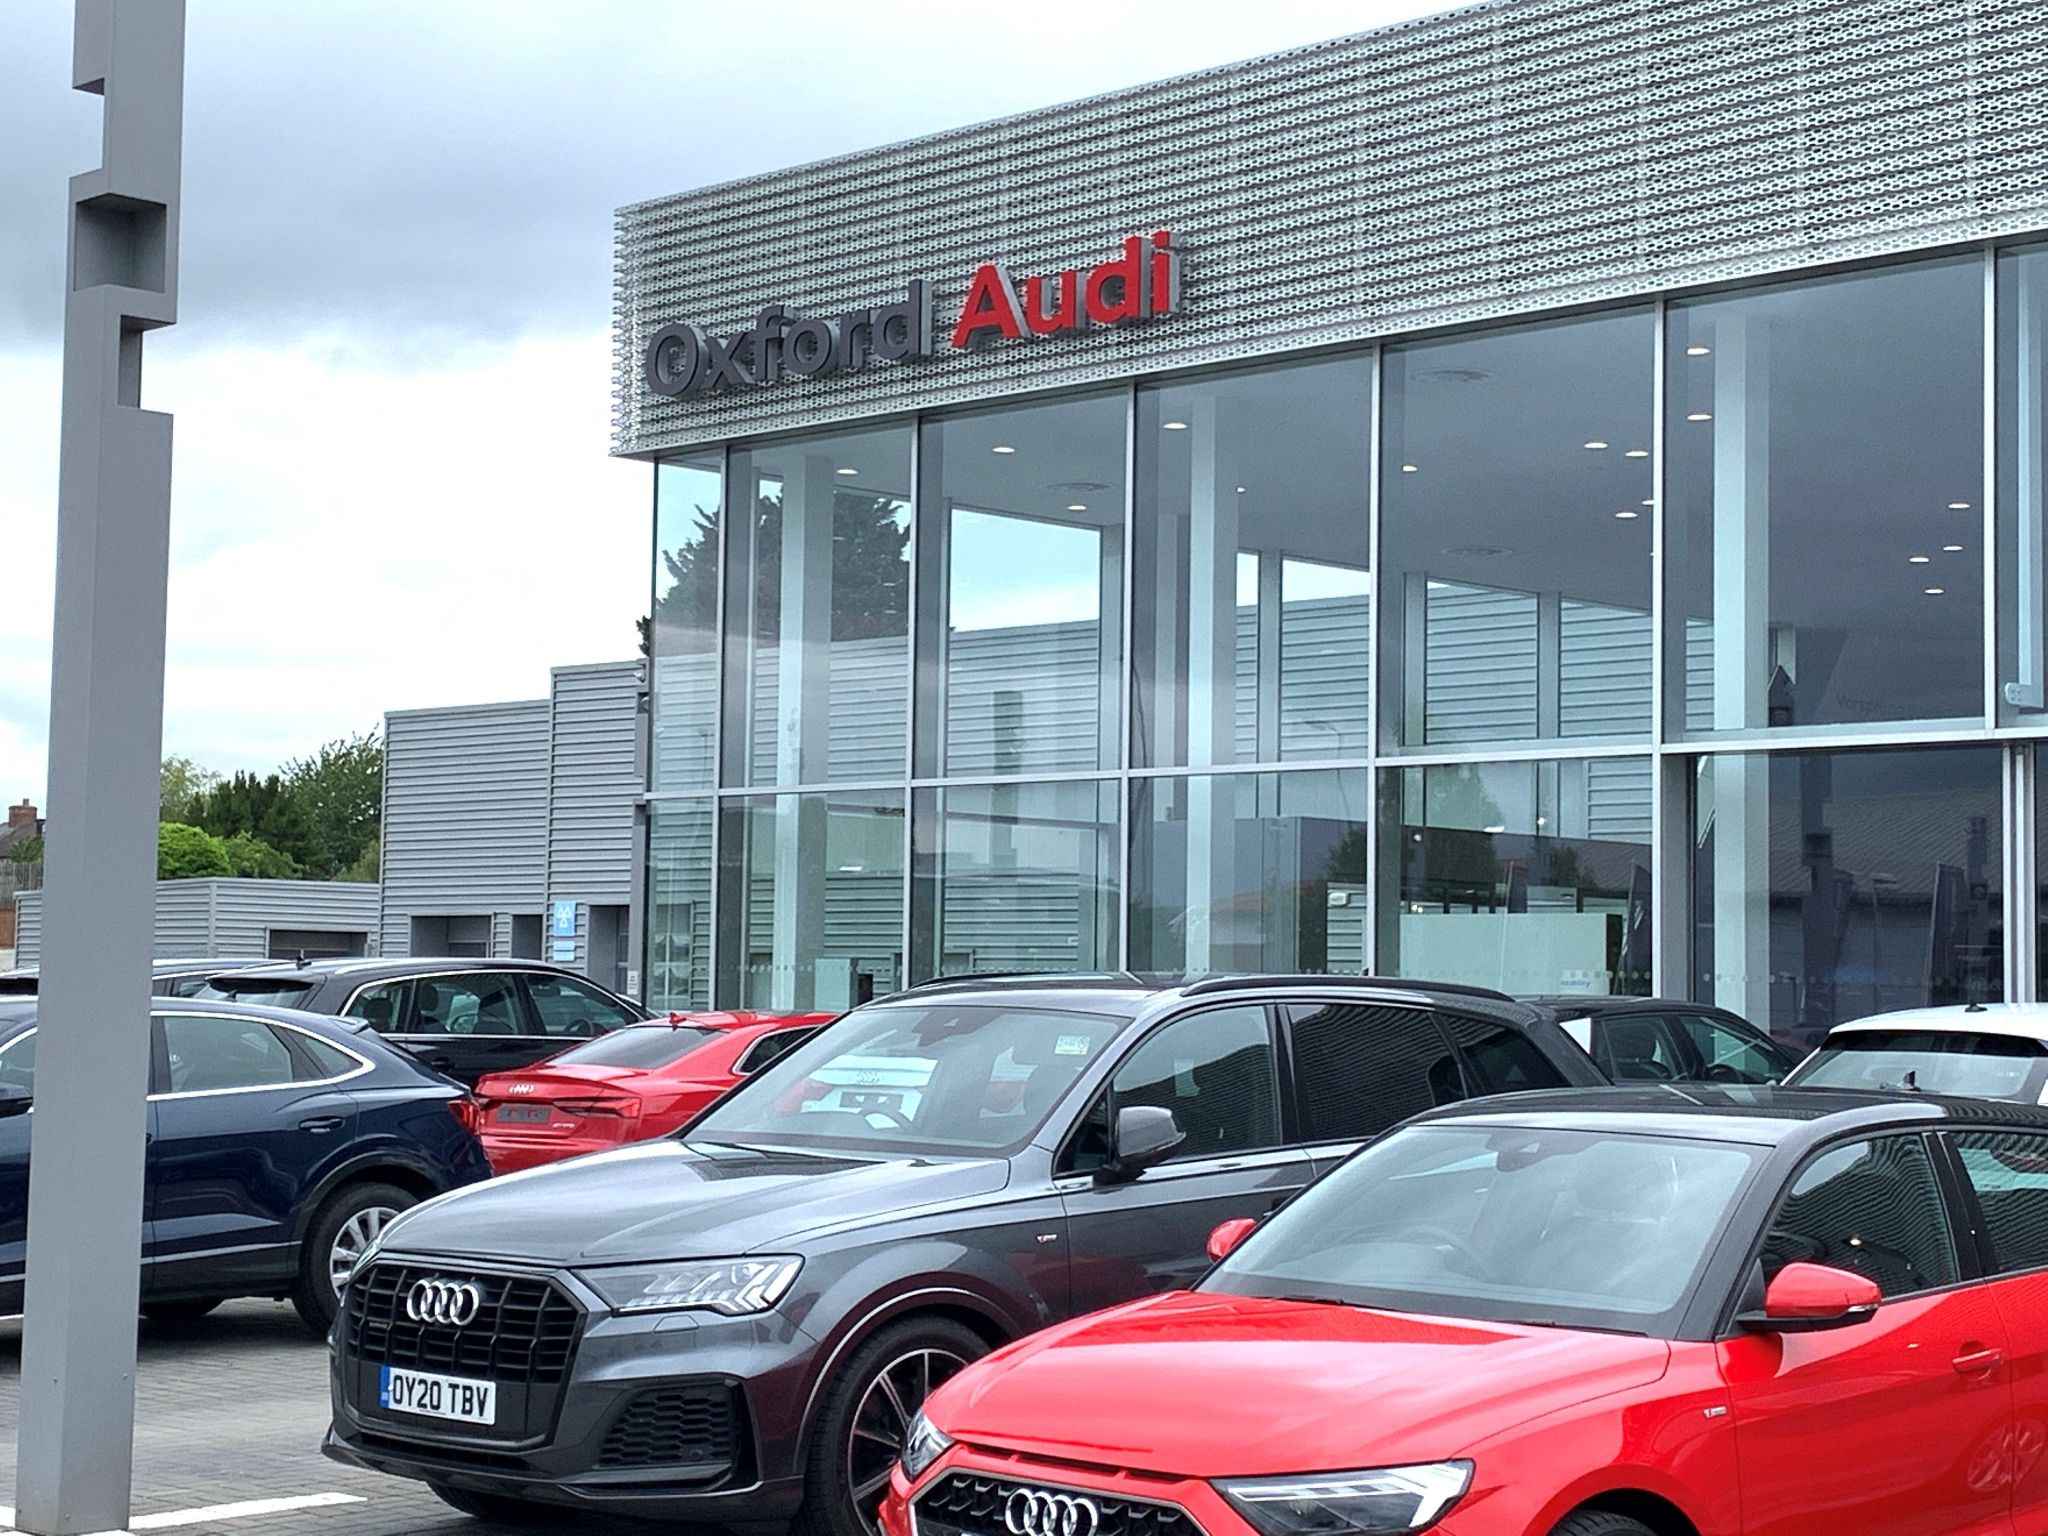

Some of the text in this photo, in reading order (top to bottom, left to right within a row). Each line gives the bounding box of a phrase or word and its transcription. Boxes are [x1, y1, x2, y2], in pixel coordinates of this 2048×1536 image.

[646, 230, 1179, 396] Oxford Audi
[393, 1374, 489, 1417] OY20 TBV
